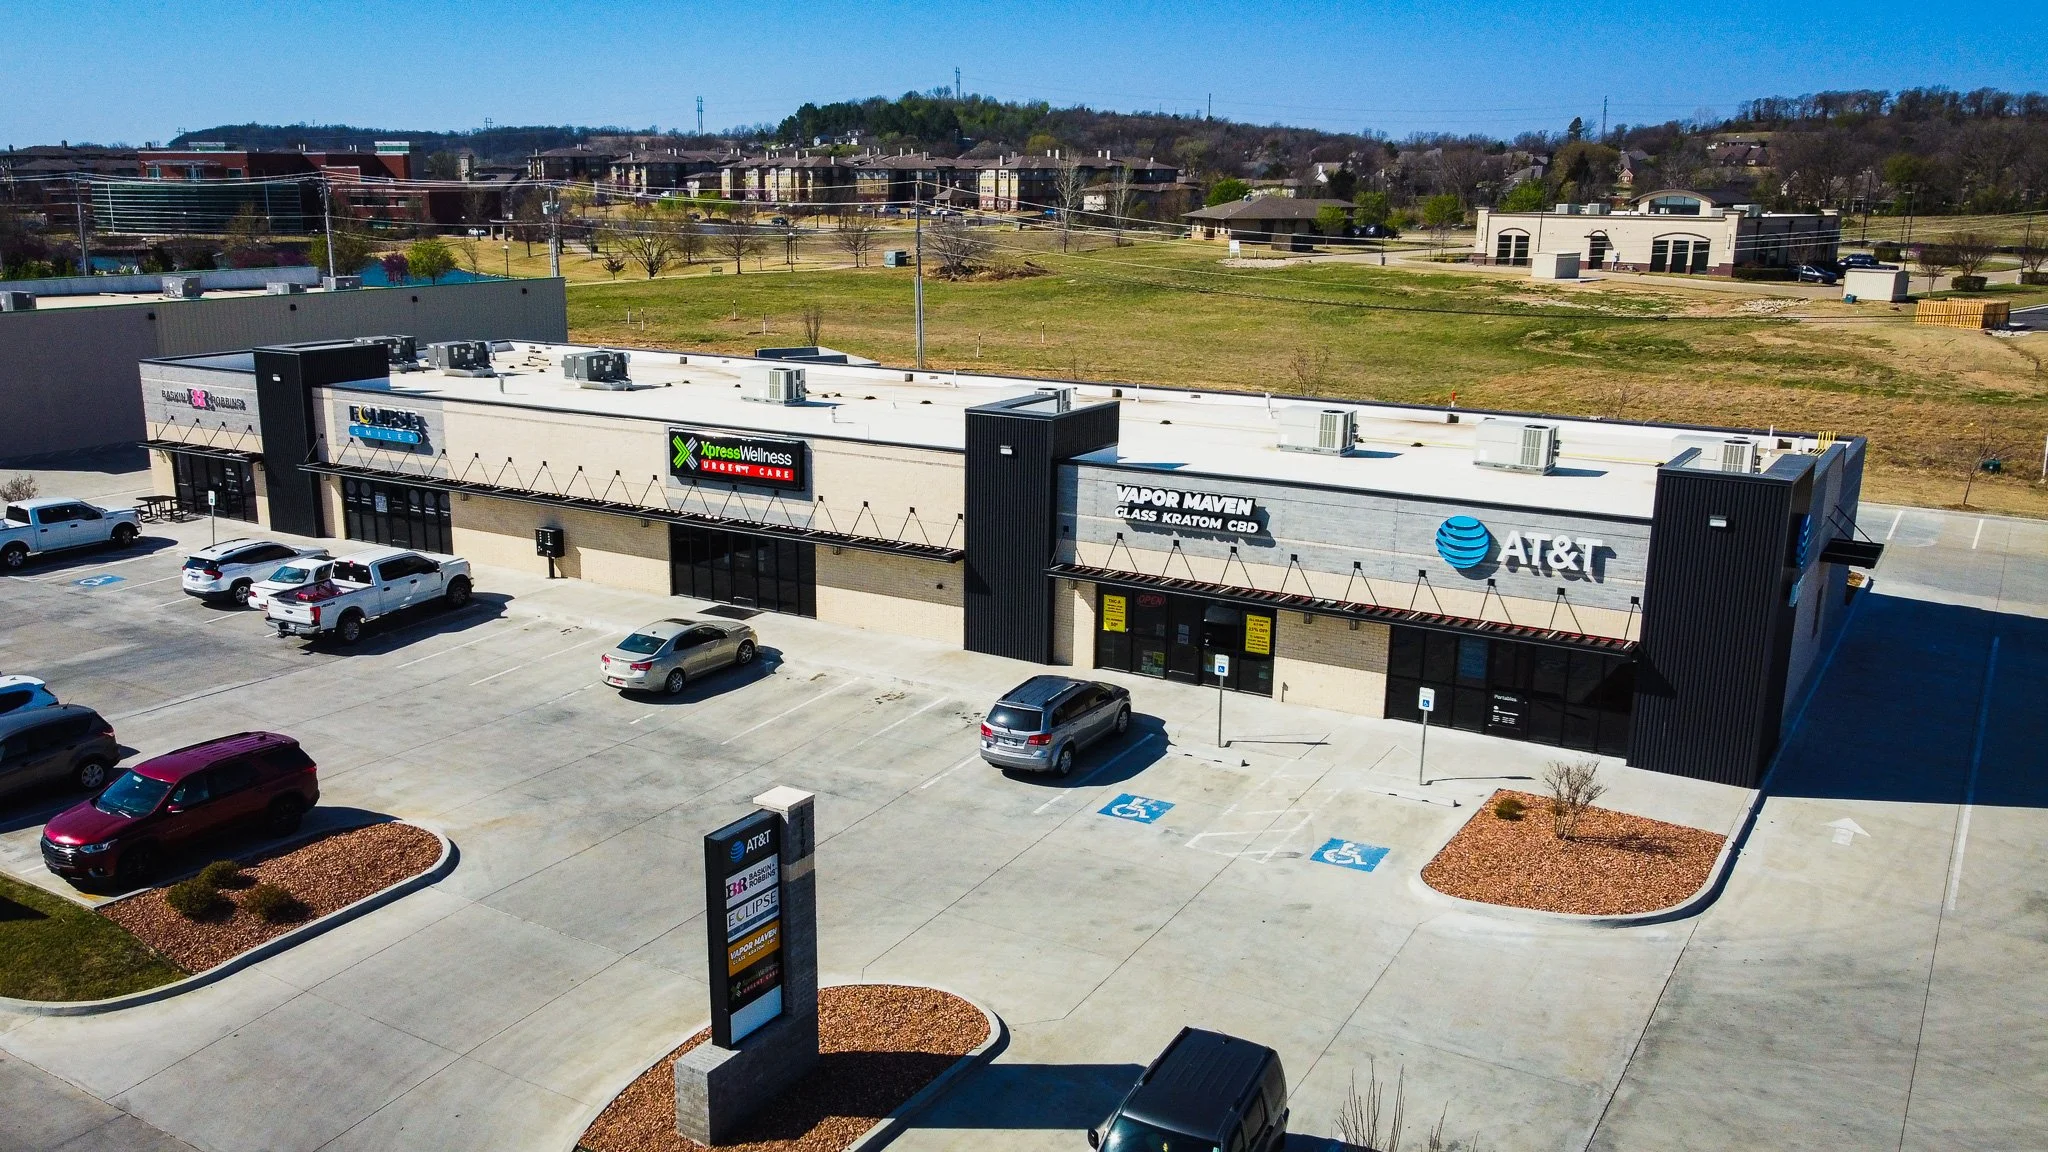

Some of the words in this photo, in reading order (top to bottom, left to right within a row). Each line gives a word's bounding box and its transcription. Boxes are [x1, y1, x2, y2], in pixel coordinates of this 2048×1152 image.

[161, 389, 187, 401] BASKIN
[211, 395, 243, 408] ROBBINS
[348, 403, 420, 430] ECLIPSE
[354, 428, 414, 442] SMILES
[700, 440, 793, 466] XpressWellness
[703, 460, 750, 475] URGENT
[759, 467, 790, 479] CARE
[1116, 484, 1179, 509] VAPOR
[1182, 491, 1254, 517] MAVEN
[1114, 505, 1158, 523] GLASS
[1161, 511, 1223, 530] KRATOM
[1227, 519, 1259, 534] CBD
[1496, 529, 1603, 573] AT&T
[746, 829, 772, 854] AT&T
[748, 868, 776, 889] ROBBINS
[728, 889, 778, 928] ECLIPSE
[730, 941, 754, 960] VAPOR
[754, 927, 778, 947] MAVEN
